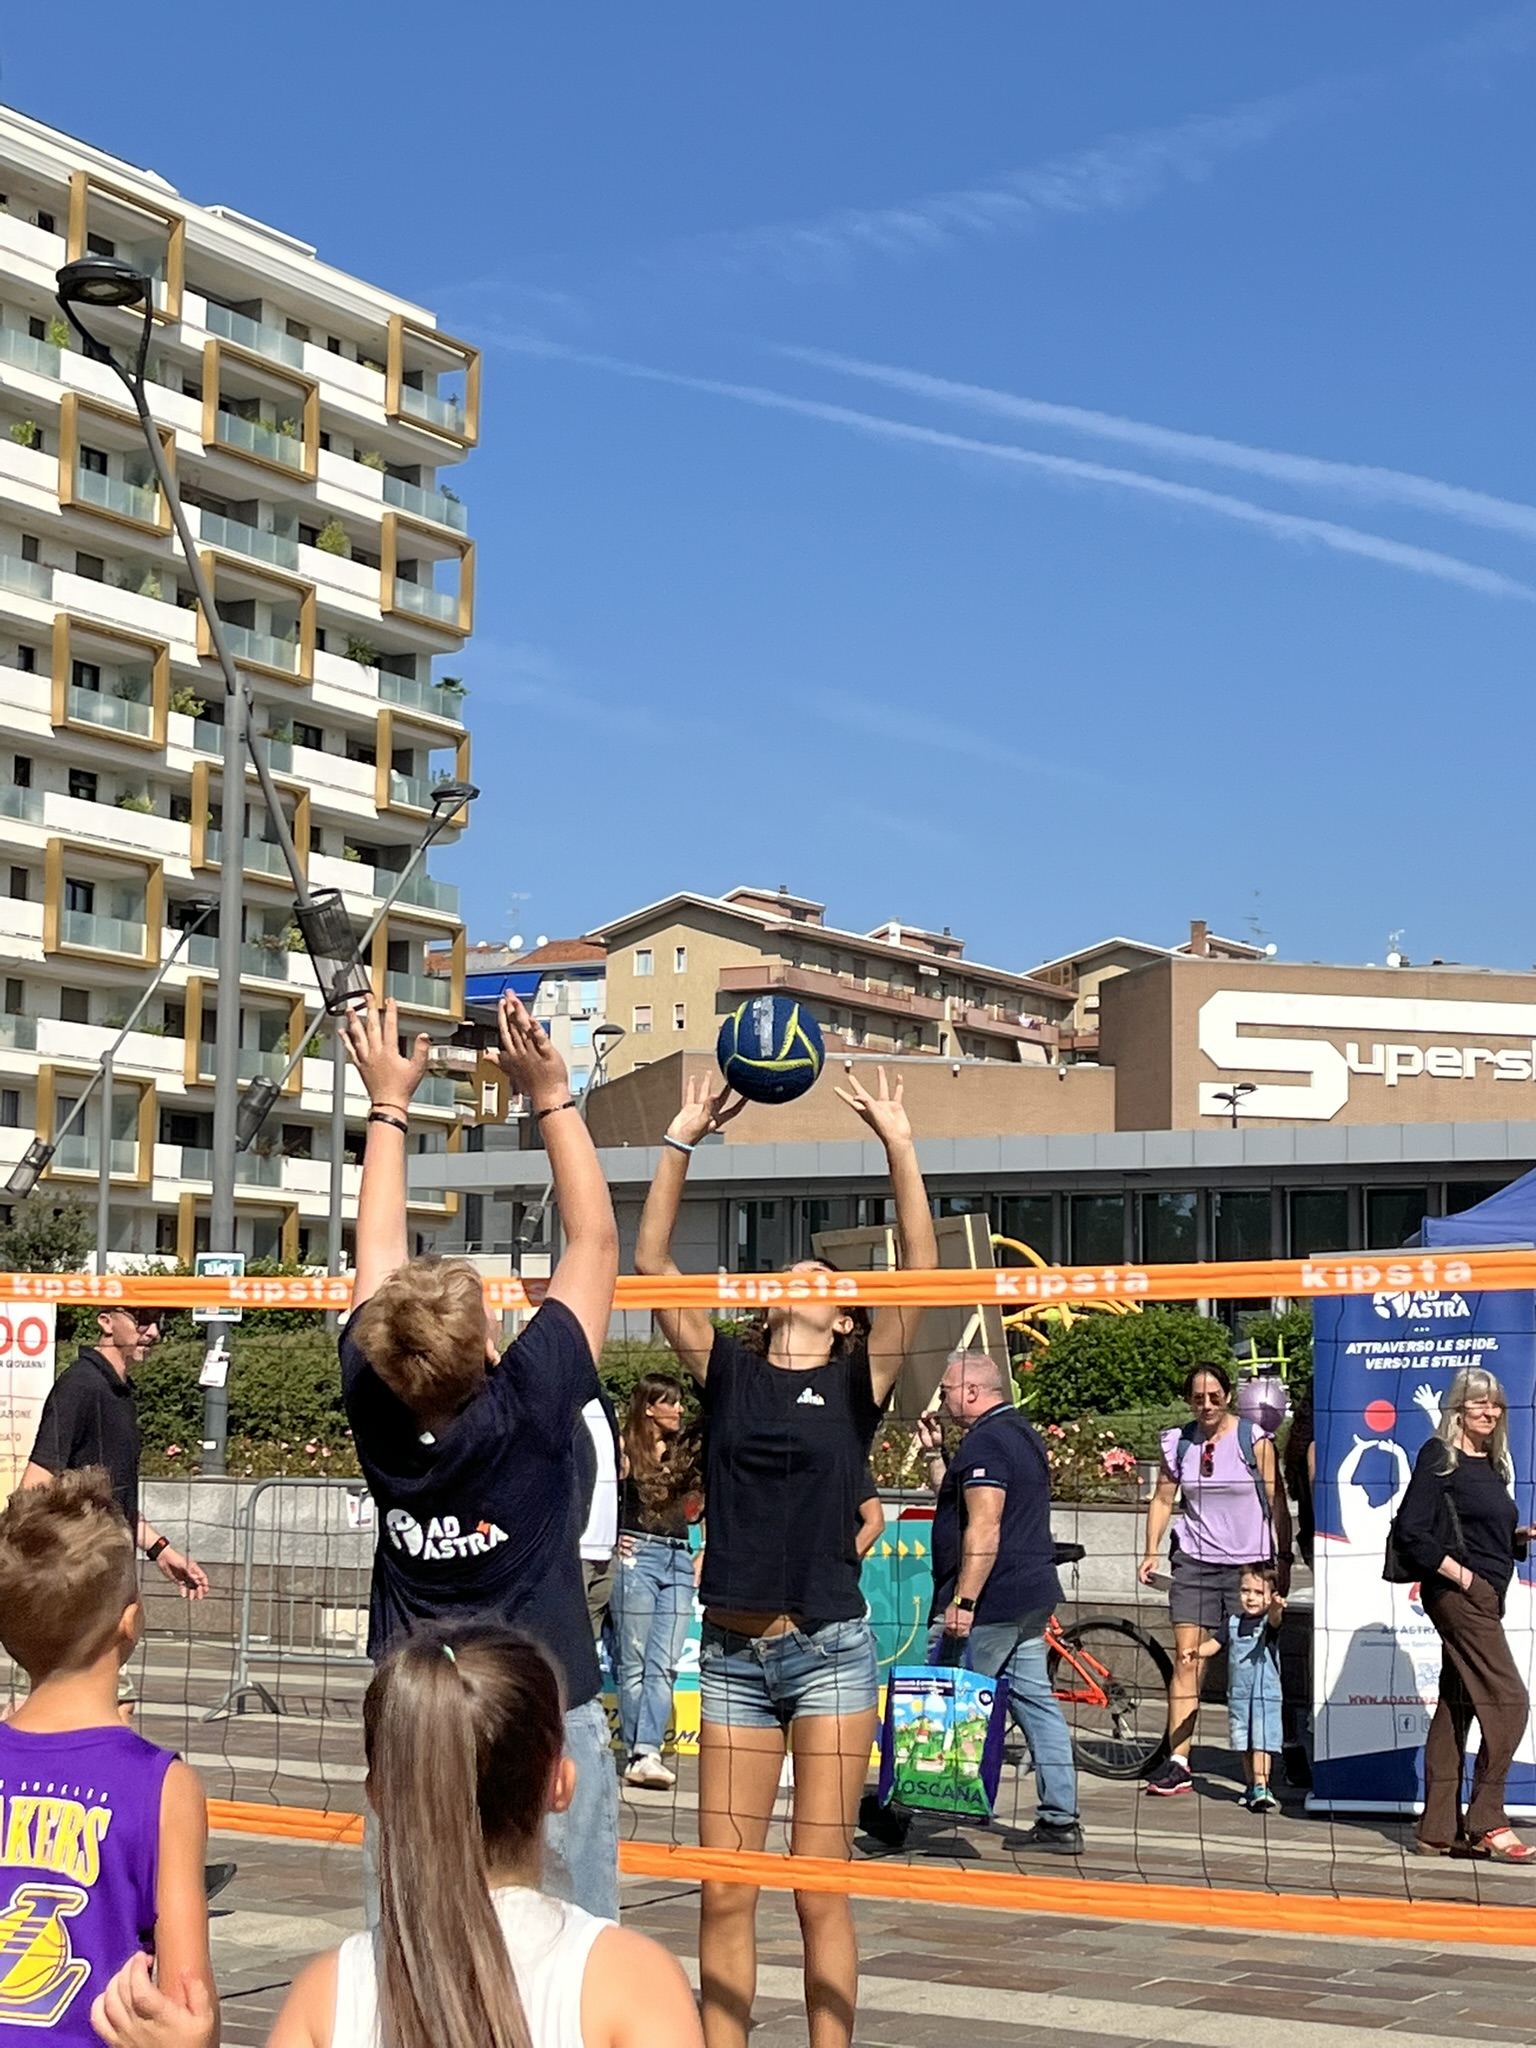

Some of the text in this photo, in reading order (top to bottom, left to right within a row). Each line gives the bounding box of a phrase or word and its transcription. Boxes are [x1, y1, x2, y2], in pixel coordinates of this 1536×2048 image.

[12, 1275, 124, 1298] kipsta
[228, 1278, 349, 1302] kipsta
[717, 1273, 858, 1302] kipsta
[994, 1269, 1149, 1298] kipsta
[1301, 1258, 1472, 1291] kipsta
[1407, 1299, 1471, 1319] ASTRA
[1345, 1337, 1499, 1355] ATTRAVERSO LE SFIDE,
[1365, 1354, 1482, 1370] VERSO LE STELLE
[426, 1515, 461, 1539] AD
[423, 1523, 509, 1560] ASTRA
[900, 1780, 984, 1805] OSCANA
[0, 1794, 112, 1888] KERS
